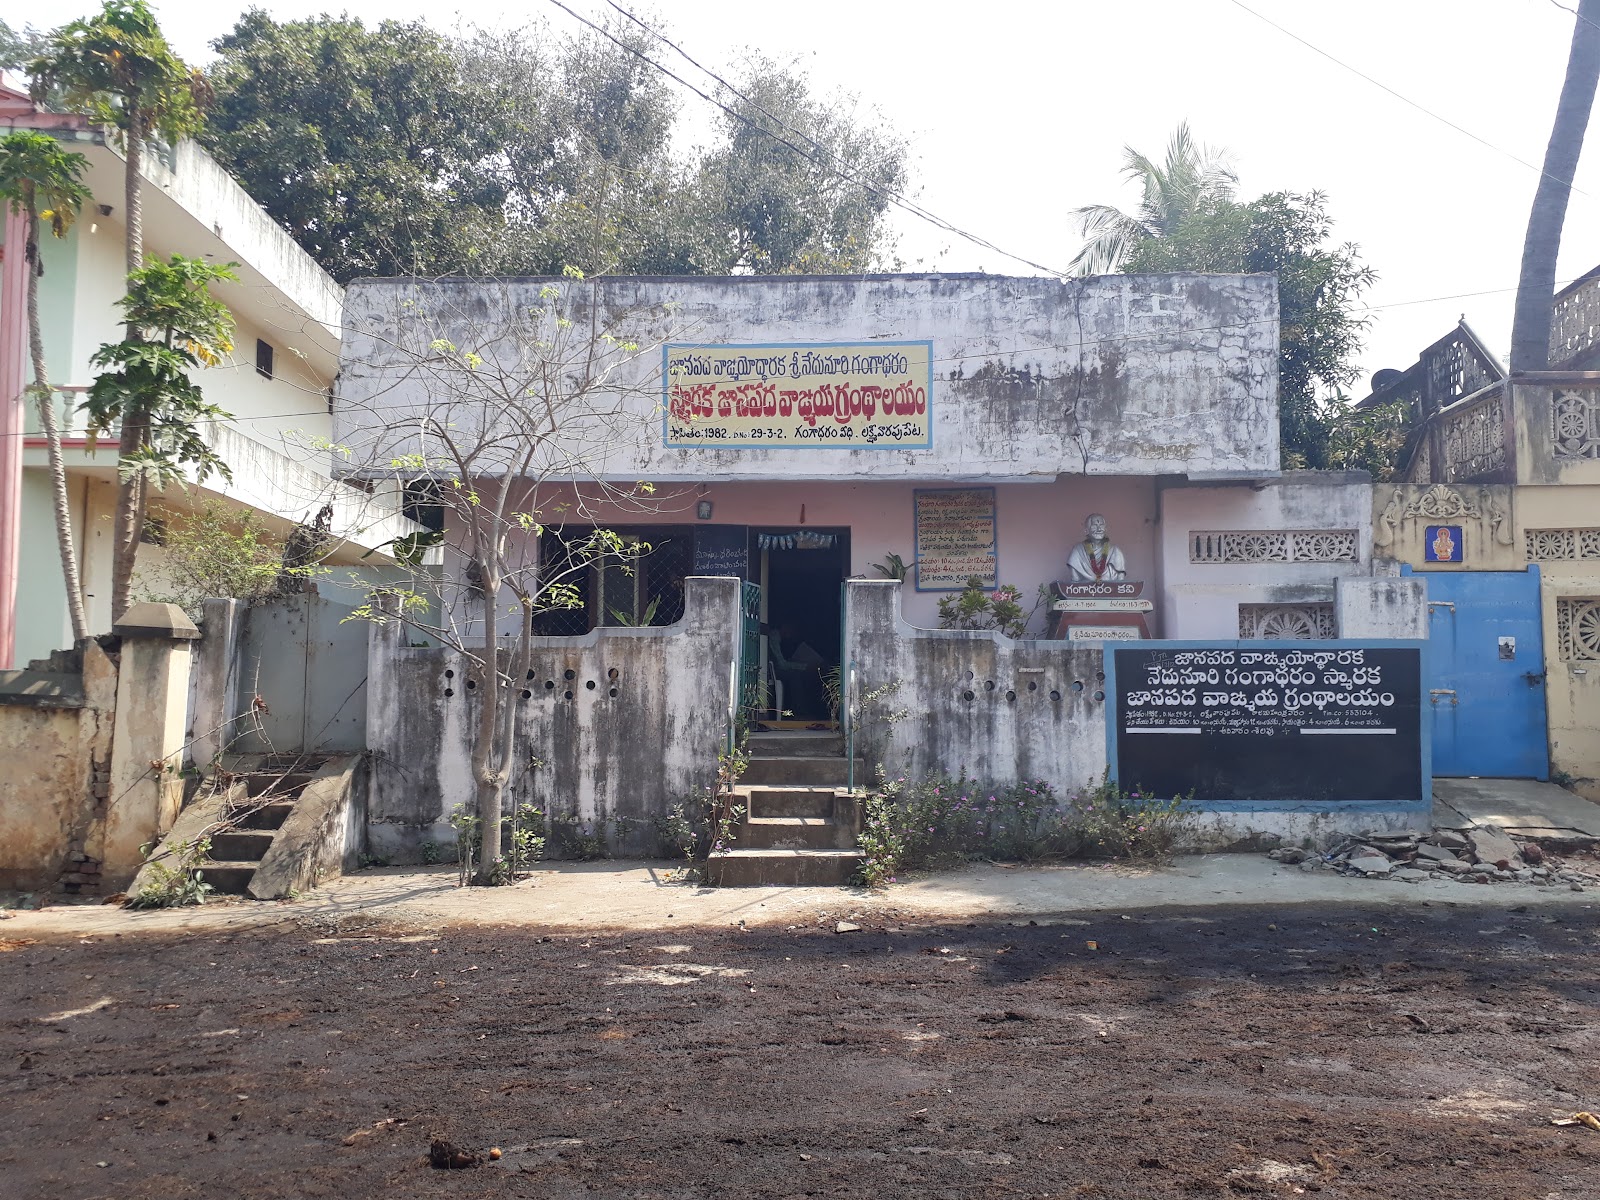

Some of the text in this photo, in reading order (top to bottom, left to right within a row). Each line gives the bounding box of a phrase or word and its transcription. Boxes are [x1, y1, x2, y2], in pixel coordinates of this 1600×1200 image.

[789, 351, 801, 379] శ్రీ
[801, 352, 849, 375] నేదునూరి
[852, 352, 908, 378] గంగాధరం
[718, 382, 777, 417] జానపద
[794, 425, 838, 441] గంగాధరం
[1066, 583, 1135, 596] గంగాధరం కవి
[1174, 650, 1235, 665] జానపద
[1147, 665, 1381, 690] నేదునూరి గంగాధరం స్మారక
[1127, 687, 1395, 711] జానపద వాఙ్మయ గ్రంథాలయం
